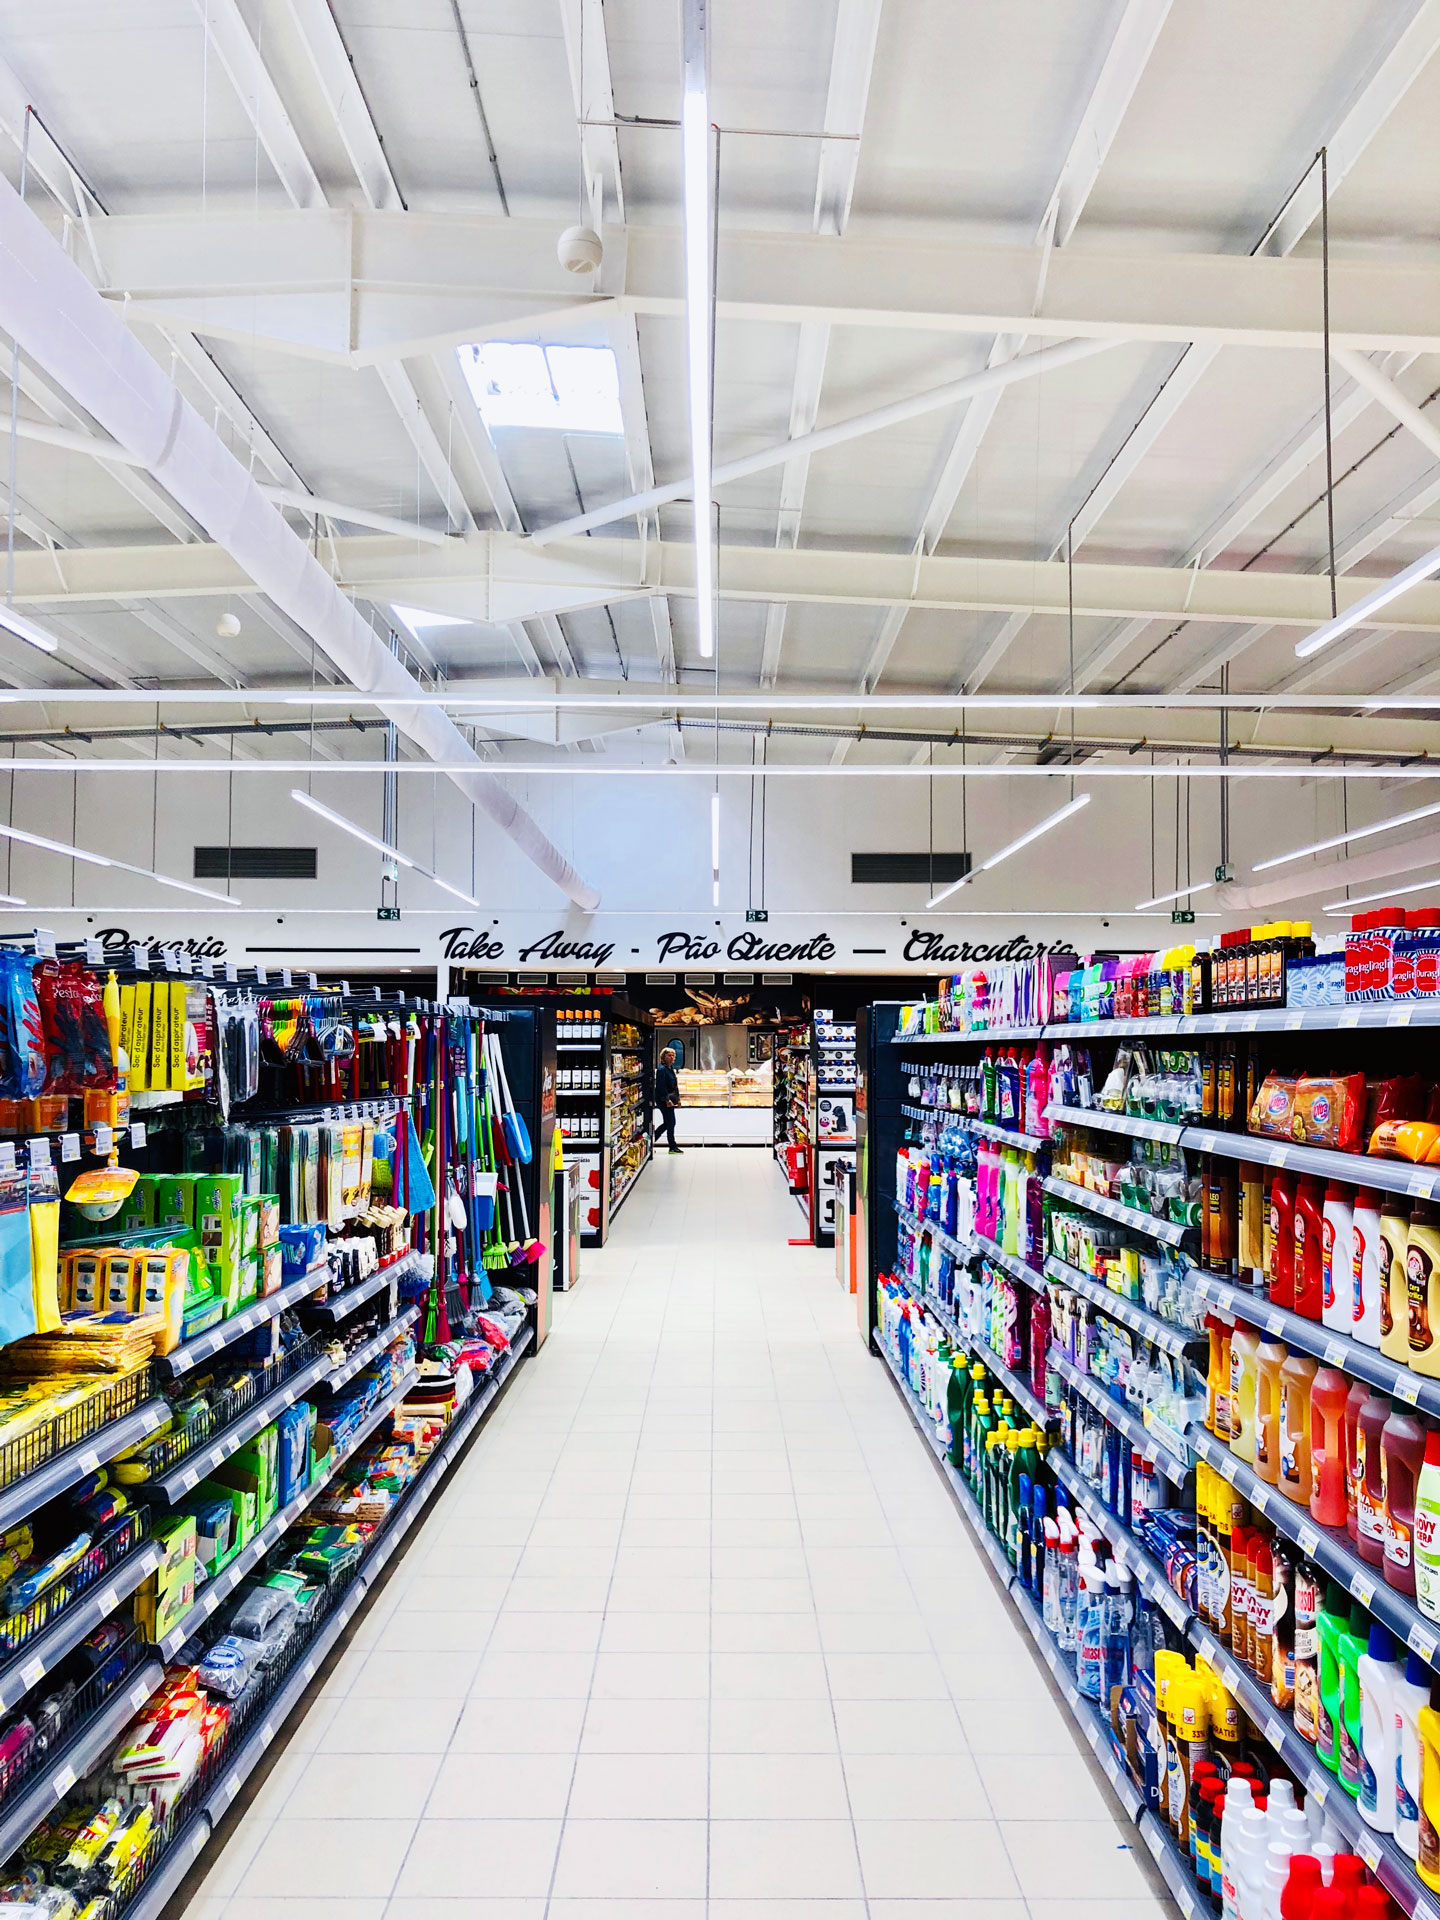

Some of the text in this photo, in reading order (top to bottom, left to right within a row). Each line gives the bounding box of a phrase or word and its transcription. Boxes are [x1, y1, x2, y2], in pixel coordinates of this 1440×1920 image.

[439, 927, 616, 969] Take Away
[657, 931, 837, 964] Pão Quente
[903, 929, 1074, 962] Charcutaria
[1416, 967, 1440, 980] Duragl
[120, 1011, 128, 1050] spirateur
[132, 1054, 140, 1069] Sac
[153, 1054, 161, 1068] Sac
[172, 1054, 180, 1068] Sac
